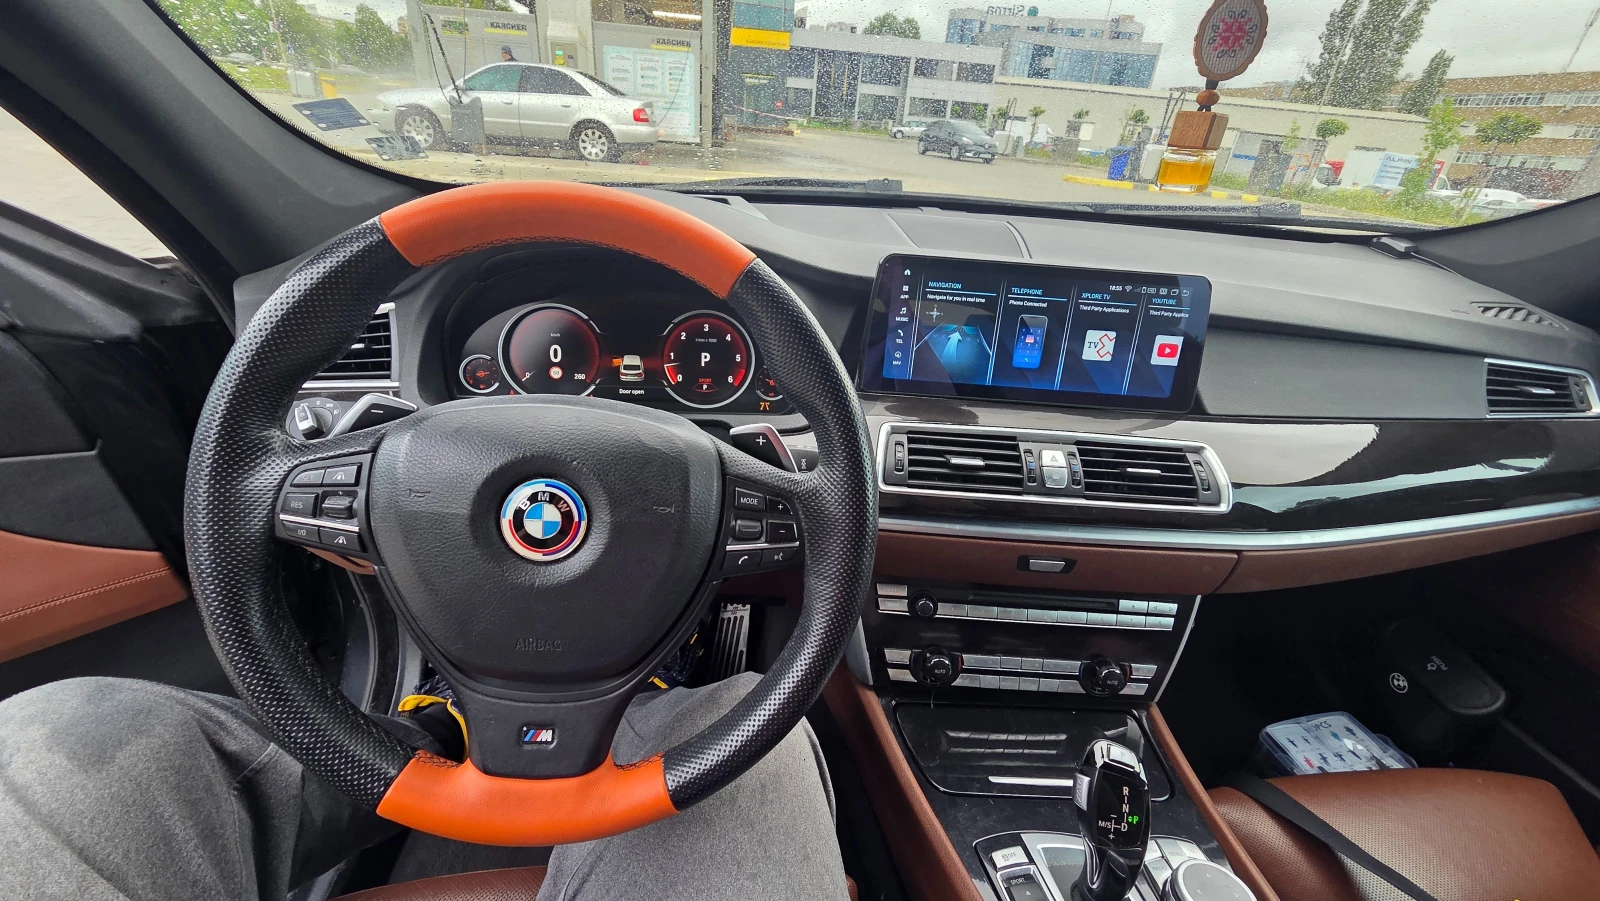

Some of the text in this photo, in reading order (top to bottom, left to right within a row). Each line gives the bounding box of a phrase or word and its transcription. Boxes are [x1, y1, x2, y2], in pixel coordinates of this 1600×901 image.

[1385, 156, 1412, 164] ALPIN
[928, 281, 962, 289] NAVIGATION
[1011, 287, 1043, 295] TELEPHONE
[1103, 306, 1130, 314] Applications
[703, 324, 709, 332] 3
[680, 332, 686, 340] 2
[725, 333, 731, 342] 4
[1088, 341, 1099, 349] TV
[549, 344, 562, 363] 0
[669, 352, 674, 360] 1
[735, 354, 741, 362] 5
[701, 352, 711, 367] P
[677, 374, 683, 382] 0
[727, 375, 734, 383] 6
[290, 500, 303, 509] RES
[518, 491, 571, 512] BMW
[740, 496, 758, 505] MODE
[515, 638, 562, 651] AIRBAG
[1122, 786, 1129, 796] R
[1122, 803, 1129, 813] N
[1098, 820, 1112, 829] M/S
[1133, 815, 1139, 825] P
[1121, 822, 1128, 832] D
[1010, 877, 1026, 886] SPORT
